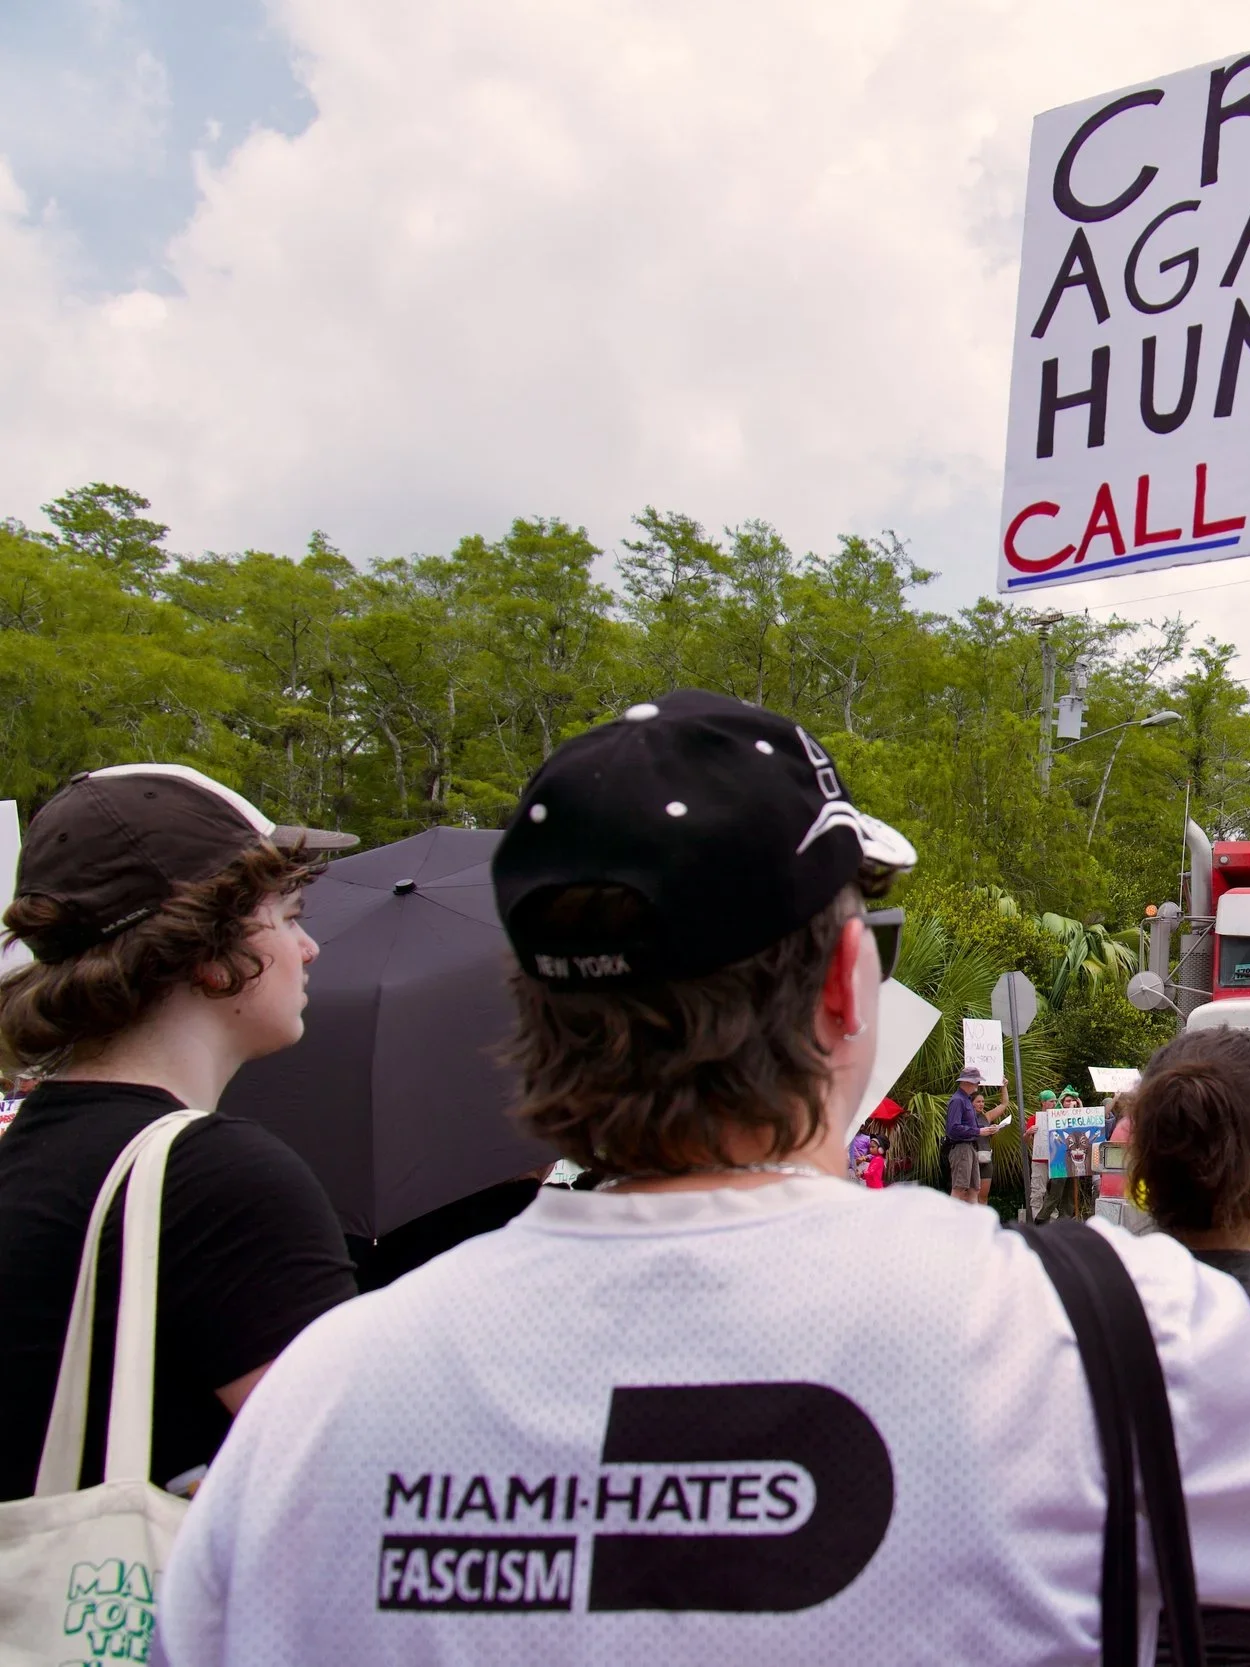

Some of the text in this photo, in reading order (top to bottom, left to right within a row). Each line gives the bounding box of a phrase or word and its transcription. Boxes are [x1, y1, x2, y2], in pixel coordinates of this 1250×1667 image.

[1003, 463, 1246, 573] CALL
[1055, 1115, 1104, 1128] EVERGLADES
[381, 1547, 574, 1602] FASCISM
